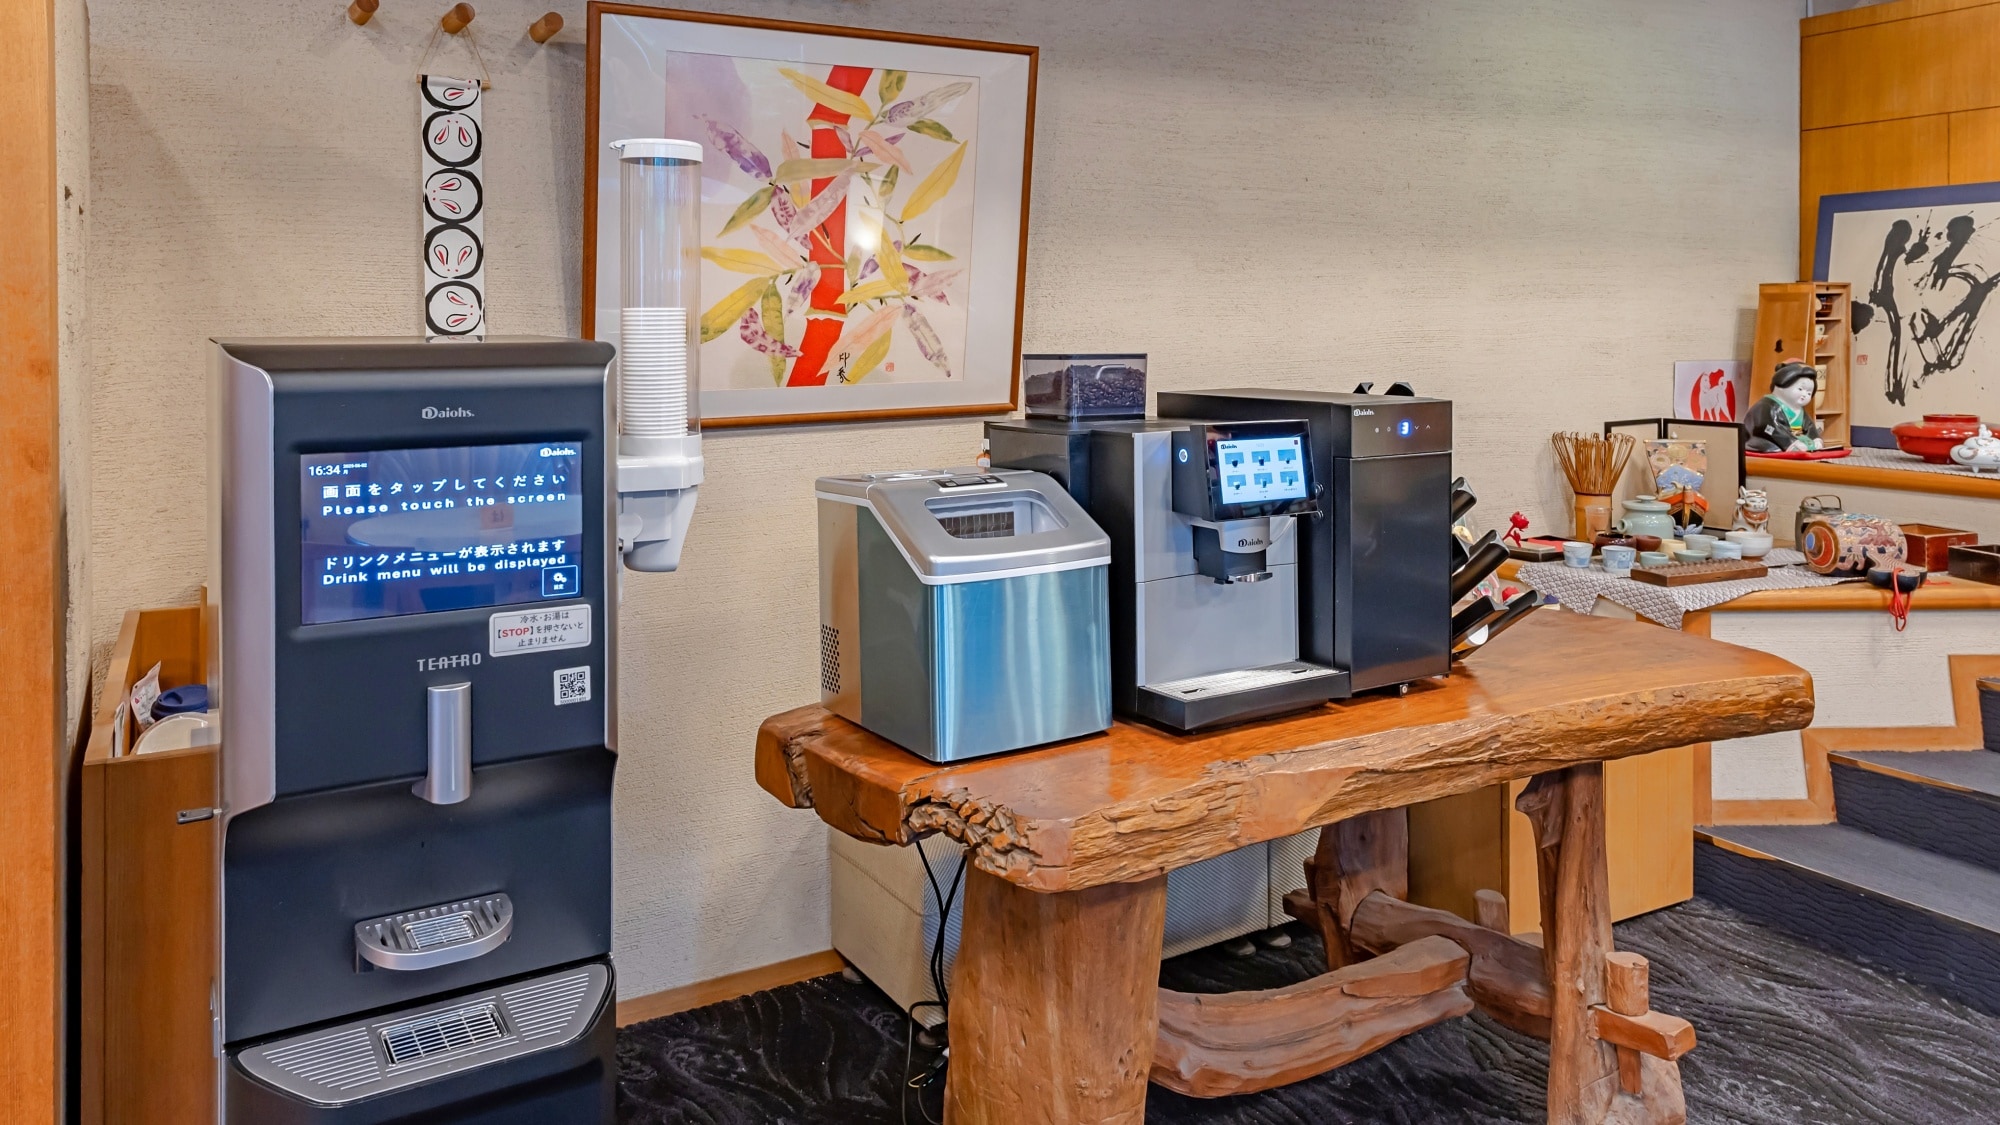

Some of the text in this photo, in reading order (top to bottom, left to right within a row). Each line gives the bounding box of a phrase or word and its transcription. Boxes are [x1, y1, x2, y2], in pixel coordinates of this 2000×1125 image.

[1401, 421, 1409, 435] 3
[308, 465, 341, 476] 16:34
[323, 474, 565, 499] 画面をタップしてください
[323, 493, 566, 516] Please touch the screen
[326, 539, 565, 570] ドリンクメニューが表示されます
[323, 554, 566, 585] Drink menu will be displayed
[518, 634, 566, 647] 止まりません
[416, 652, 482, 672] TEATRO
